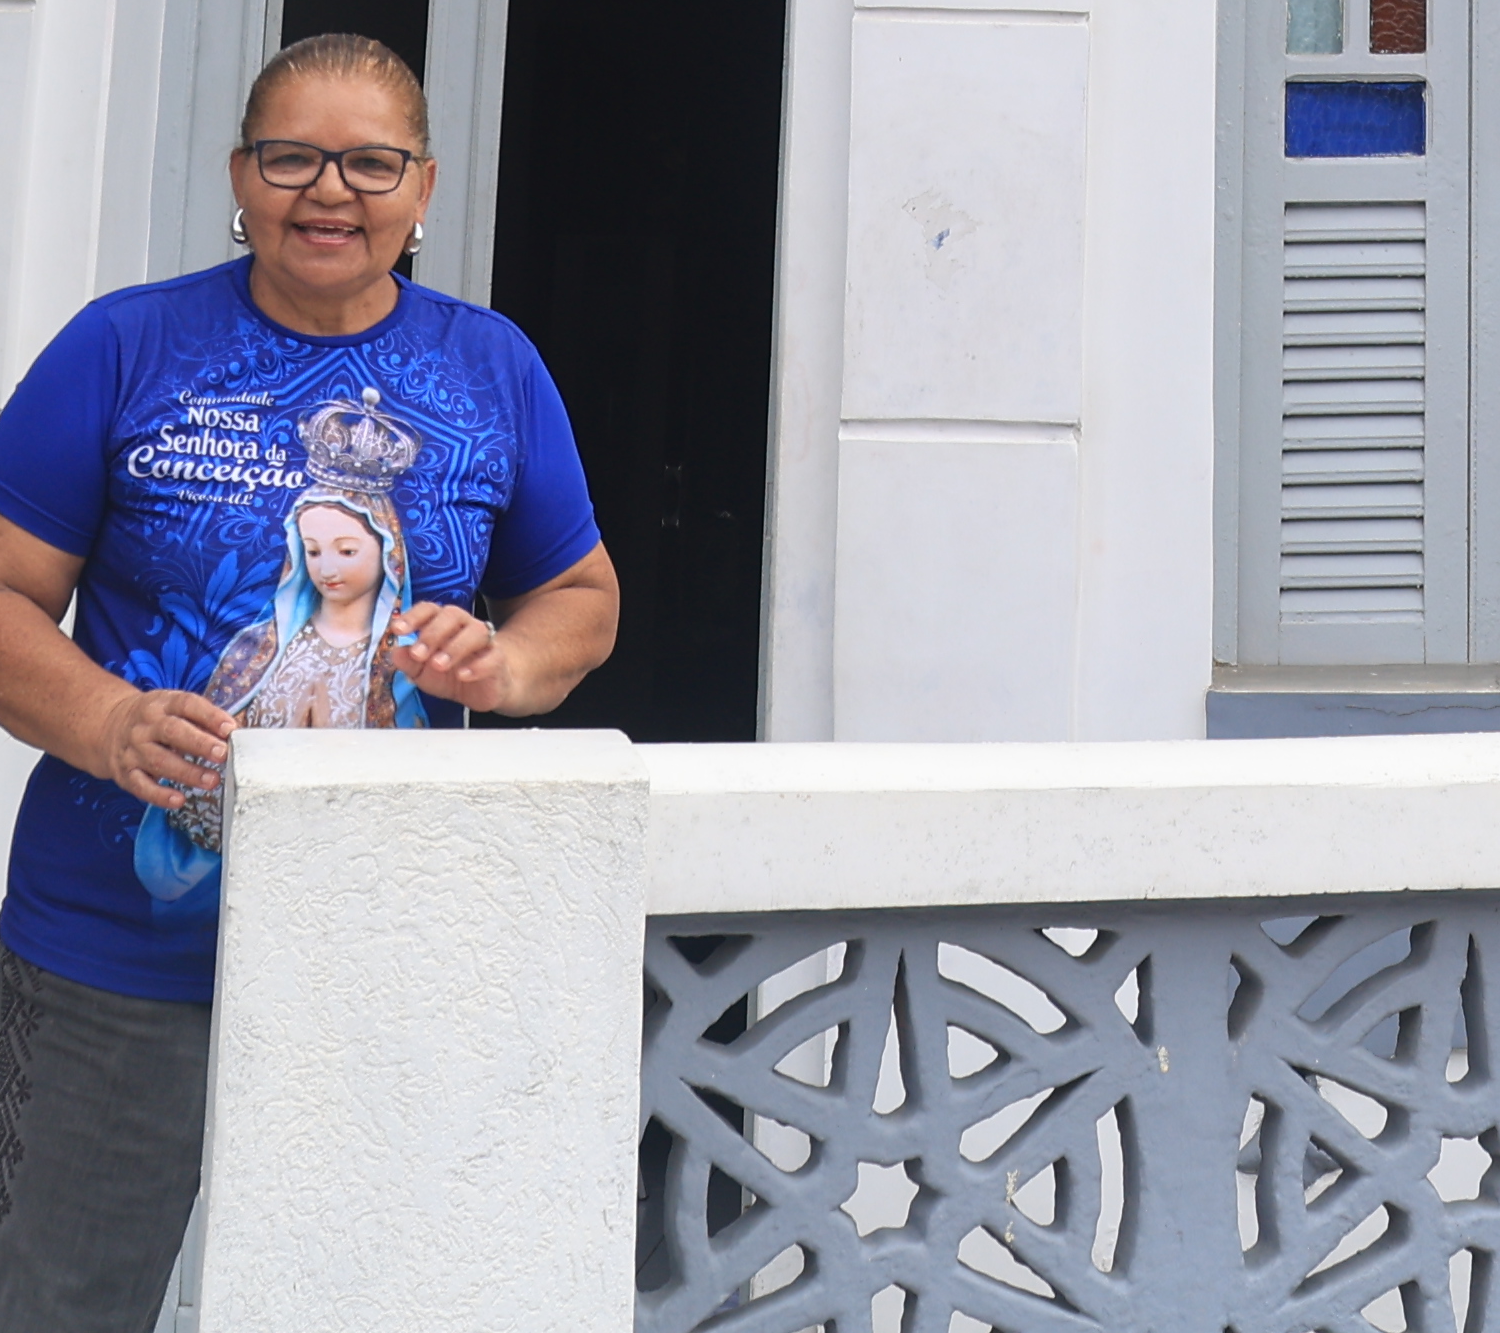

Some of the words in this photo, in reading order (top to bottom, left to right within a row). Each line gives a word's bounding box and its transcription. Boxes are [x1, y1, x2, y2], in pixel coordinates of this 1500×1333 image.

[179, 390, 275, 407] Comunidade
[156, 424, 259, 460] Senhora
[265, 444, 287, 461] da
[127, 445, 307, 493] Conceição
